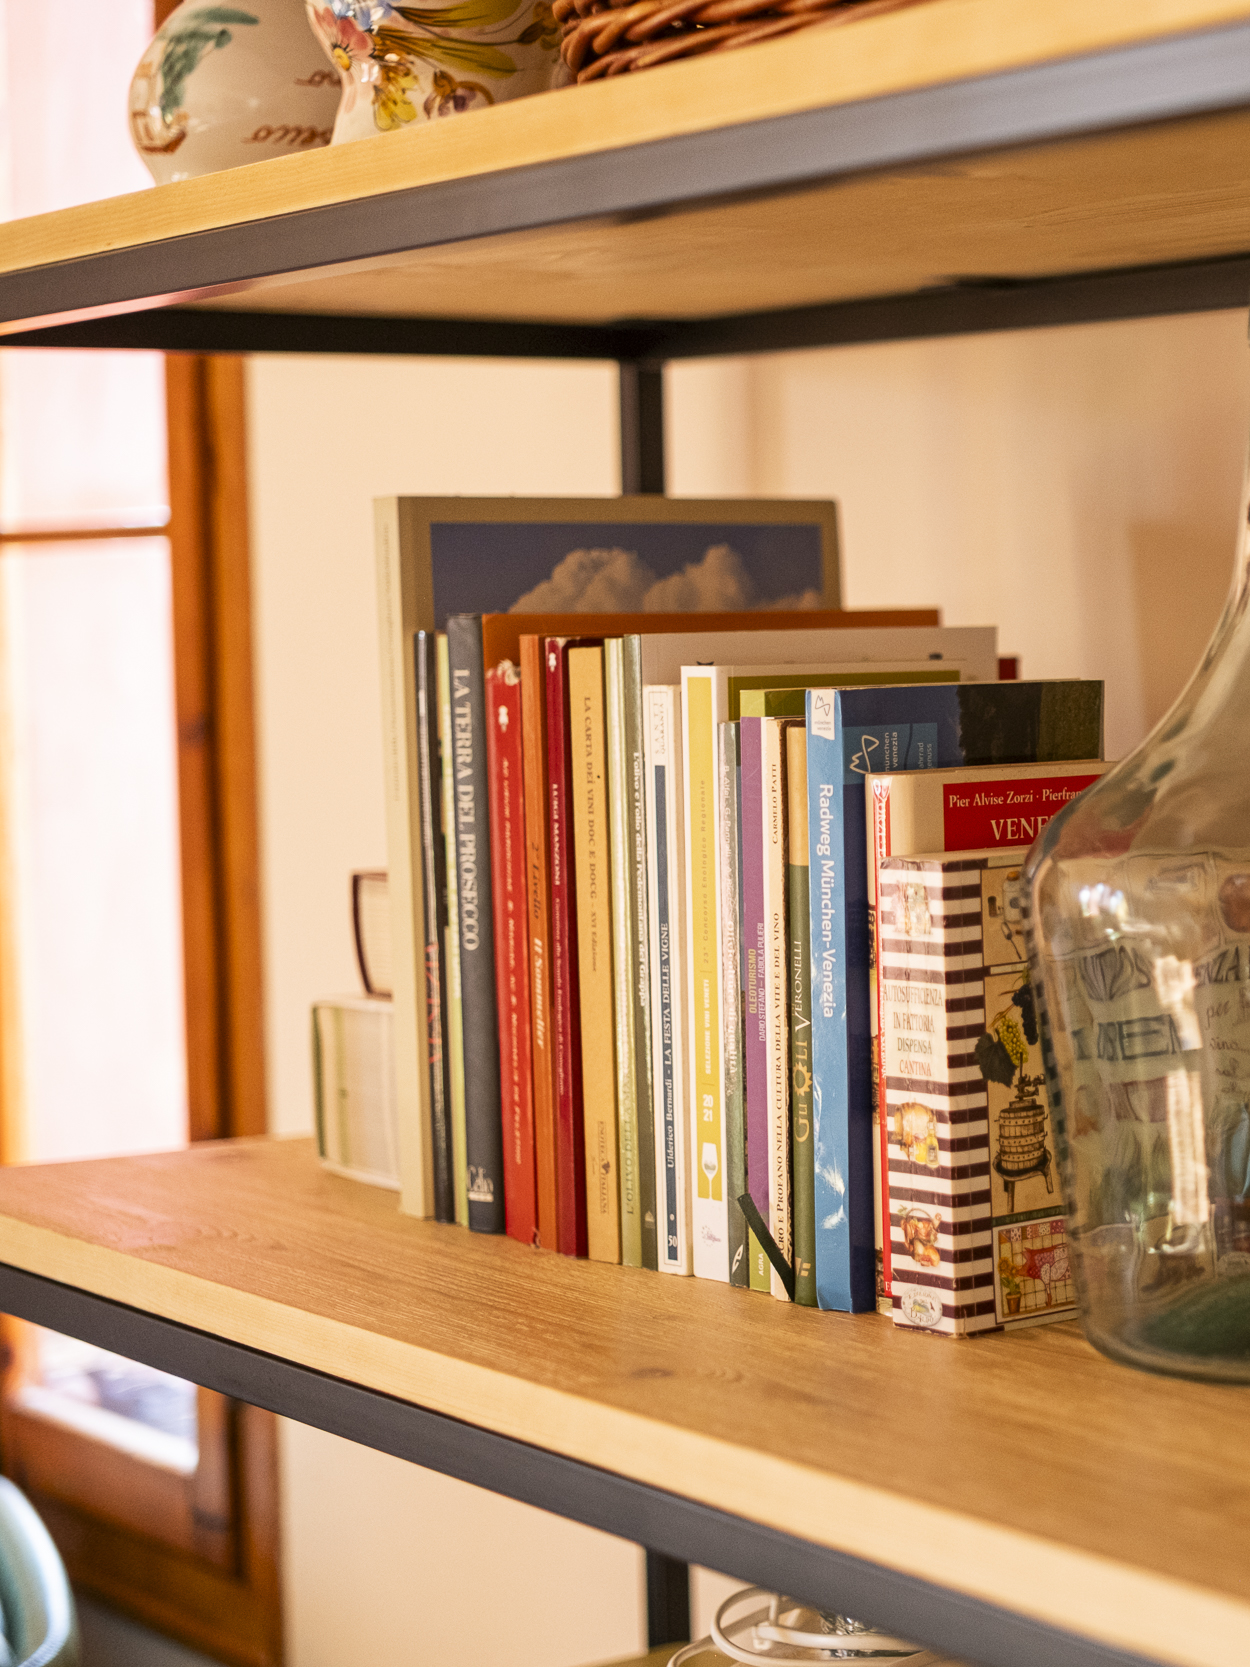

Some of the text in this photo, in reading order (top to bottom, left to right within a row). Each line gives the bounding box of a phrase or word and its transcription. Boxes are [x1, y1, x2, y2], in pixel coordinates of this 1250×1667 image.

[583, 696, 591, 712] LA
[584, 716, 592, 757] CARTA
[632, 751, 640, 789] L'olivo
[452, 668, 480, 950] LA TERRA DEL PROSECCO
[586, 788, 594, 815] VINI
[633, 791, 639, 799] e
[949, 794, 970, 808] Pier
[973, 792, 1004, 806] Alvise
[1006, 790, 1033, 804] Zorzi
[551, 783, 561, 885] LUIGI MANZONI
[587, 819, 595, 845] DOC
[633, 801, 641, 830] l'olio
[990, 816, 1053, 840] VENE
[588, 850, 596, 859] E
[634, 832, 642, 861] della
[531, 863, 541, 919] Livello
[588, 863, 597, 898] DOCG
[635, 863, 644, 940] Pedemontana
[815, 783, 836, 1017] Radweg München-Venezia
[590, 931, 598, 972] Edizione
[660, 922, 668, 960] VIGNE
[533, 937, 545, 1049] Il Sommelier
[637, 964, 646, 1006] Grappa
[661, 964, 669, 1003] DELLE
[726, 920, 737, 1073] Olivicoltura di qualità
[747, 948, 757, 1013] OLEOTURISMO
[793, 940, 810, 1031] VERONELLI
[883, 984, 943, 1006] AUTOSUFFICIENZA
[757, 988, 765, 1019] STEFANO
[893, 1012, 935, 1032] IN FATTORIA
[662, 1008, 671, 1044] FESTA
[757, 1019, 765, 1041] DARIO
[663, 1049, 672, 1065] LA
[703, 1030, 711, 1074] SELEZIONE
[897, 1037, 932, 1054] DISPENSA
[774, 1056, 782, 1109] CULTURA
[899, 1059, 932, 1076] CANTINA
[664, 1078, 673, 1121] Bernardi
[702, 1093, 713, 1107] 20
[702, 1107, 713, 1122] 21
[622, 1106, 632, 1152] DELLA
[793, 1103, 810, 1142] GLI
[665, 1125, 674, 1168] Ulderico
[624, 1156, 634, 1215] L'OLIVO
[775, 1156, 783, 1212] PROFANO
[667, 1234, 678, 1248] 50
